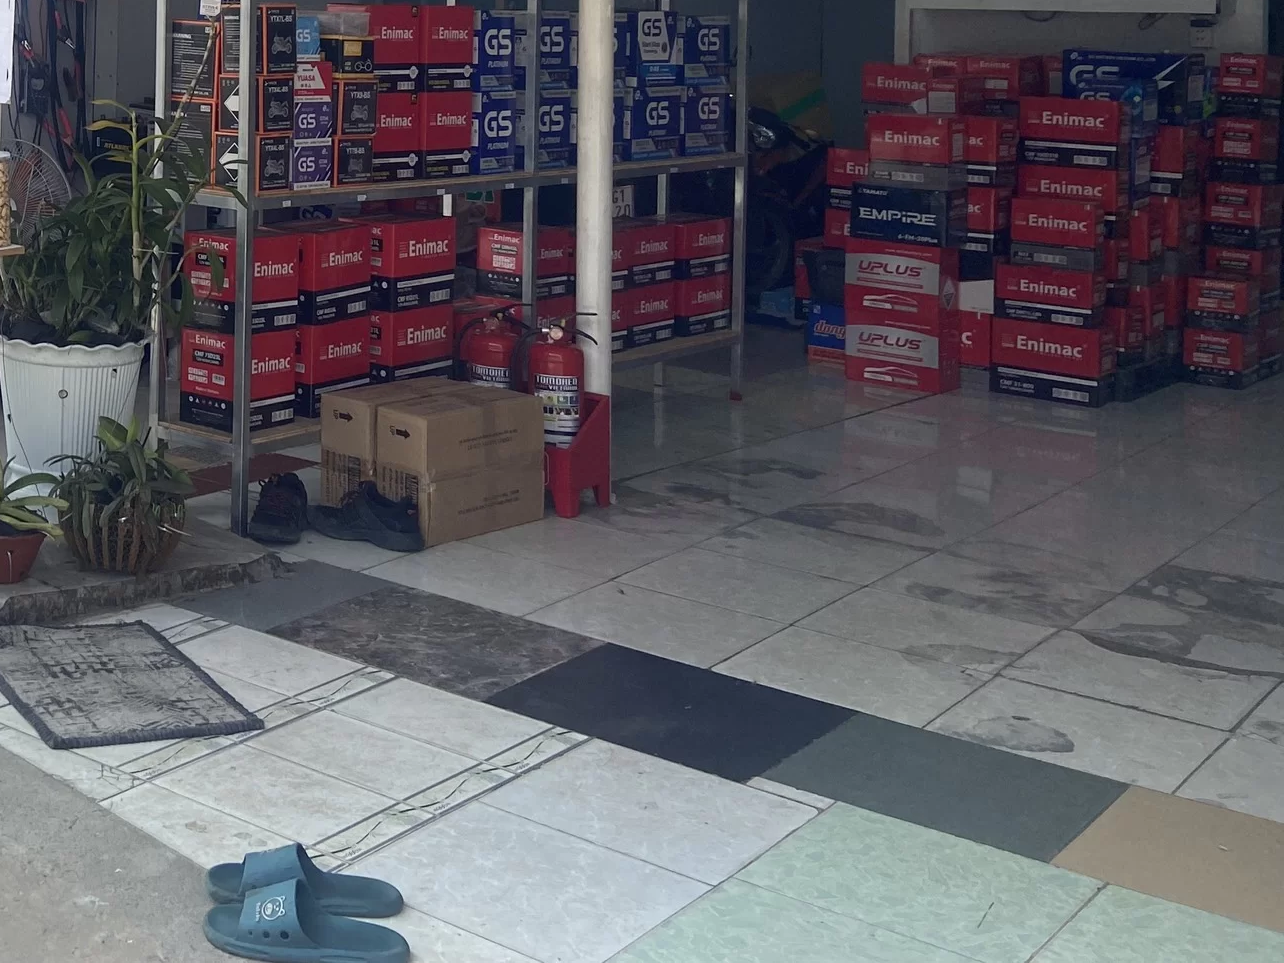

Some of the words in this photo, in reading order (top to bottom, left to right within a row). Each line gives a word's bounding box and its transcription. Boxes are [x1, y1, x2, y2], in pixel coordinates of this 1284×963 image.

[484, 28, 512, 56] GS
[698, 28, 720, 51] GS
[297, 74, 315, 82] YUASA
[484, 110, 513, 138] GS
[1042, 111, 1105, 128] Enimac
[884, 130, 940, 146] Enimac
[1040, 180, 1103, 197] Enimac
[1028, 214, 1087, 232] Enimac
[409, 239, 448, 257] Enimac
[641, 240, 668, 254] Enimac
[329, 250, 363, 266] Enimac
[254, 261, 293, 277] Enimac
[858, 261, 923, 277] UPLUS
[1020, 279, 1076, 298] Enimac
[407, 325, 447, 345] Enimac
[858, 331, 922, 350] UPLUS
[328, 341, 362, 359] Enimac
[1017, 335, 1083, 358] Enimac
[251, 356, 290, 375] Enimac
